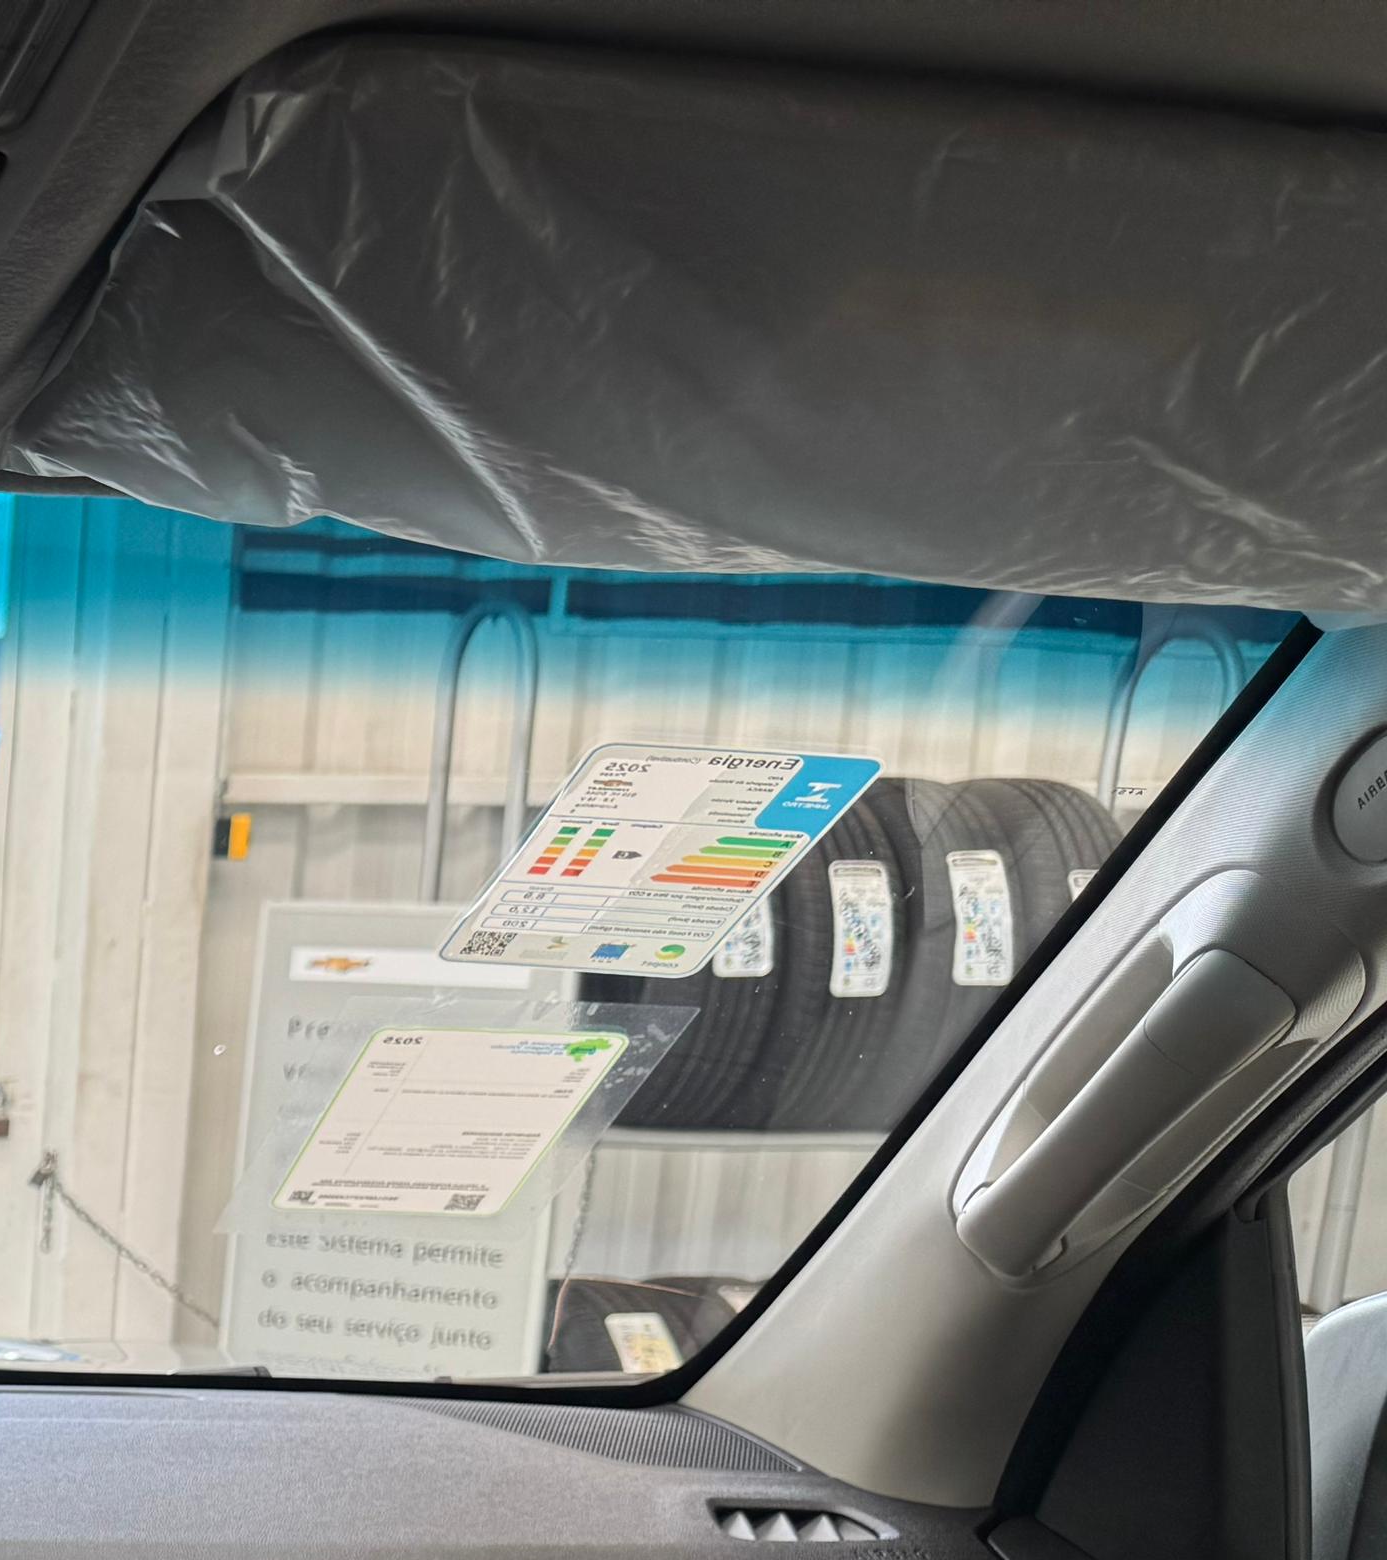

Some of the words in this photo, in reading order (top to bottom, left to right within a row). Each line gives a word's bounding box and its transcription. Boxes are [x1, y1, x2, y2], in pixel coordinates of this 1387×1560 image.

[1357, 770, 1387, 810] AIRB
[412, 1241, 505, 1269] permite
[261, 1269, 277, 1289] o
[290, 1272, 499, 1310] acompanhamento
[257, 1308, 288, 1330] do
[295, 1314, 333, 1334] seu
[344, 1318, 422, 1348] serviço
[429, 1325, 492, 1351] junto
